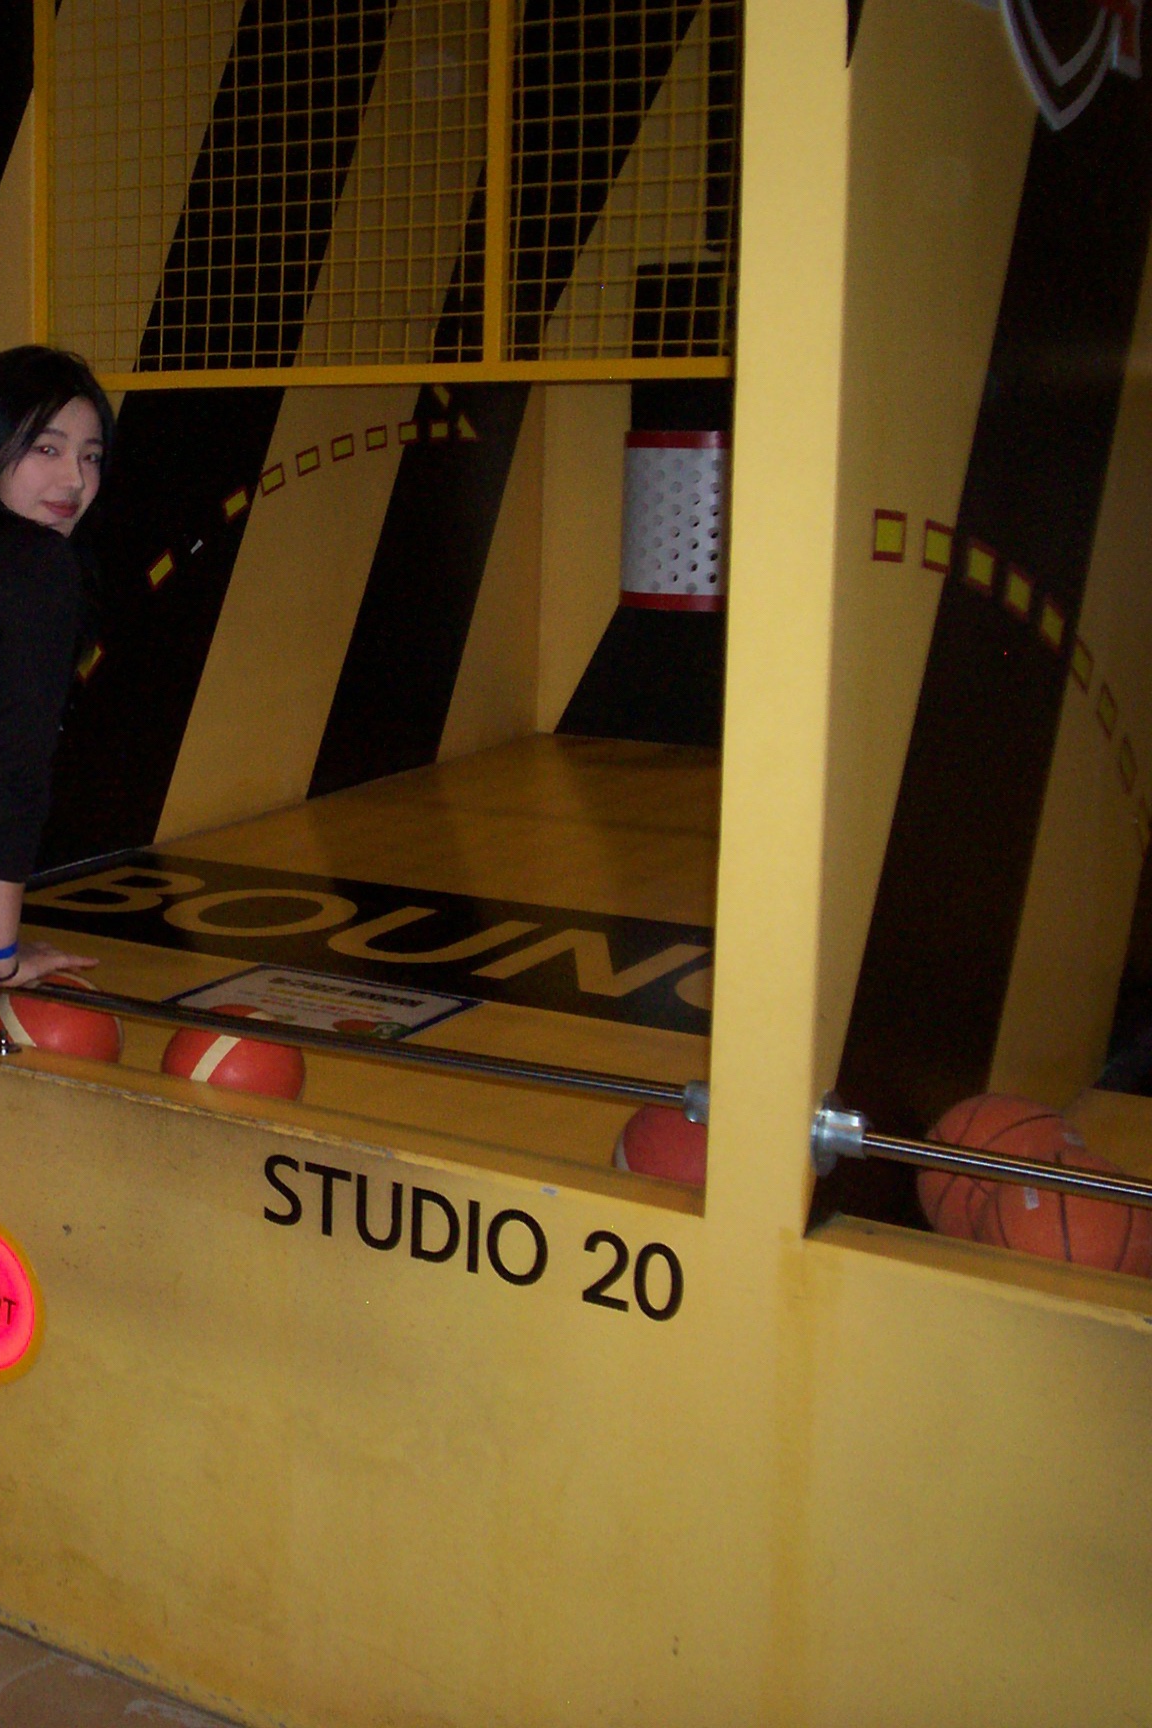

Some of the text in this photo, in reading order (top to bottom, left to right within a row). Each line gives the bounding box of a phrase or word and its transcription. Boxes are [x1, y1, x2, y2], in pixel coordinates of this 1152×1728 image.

[23, 864, 712, 1011] BOUN
[264, 1154, 684, 1321] STUDIO 20
